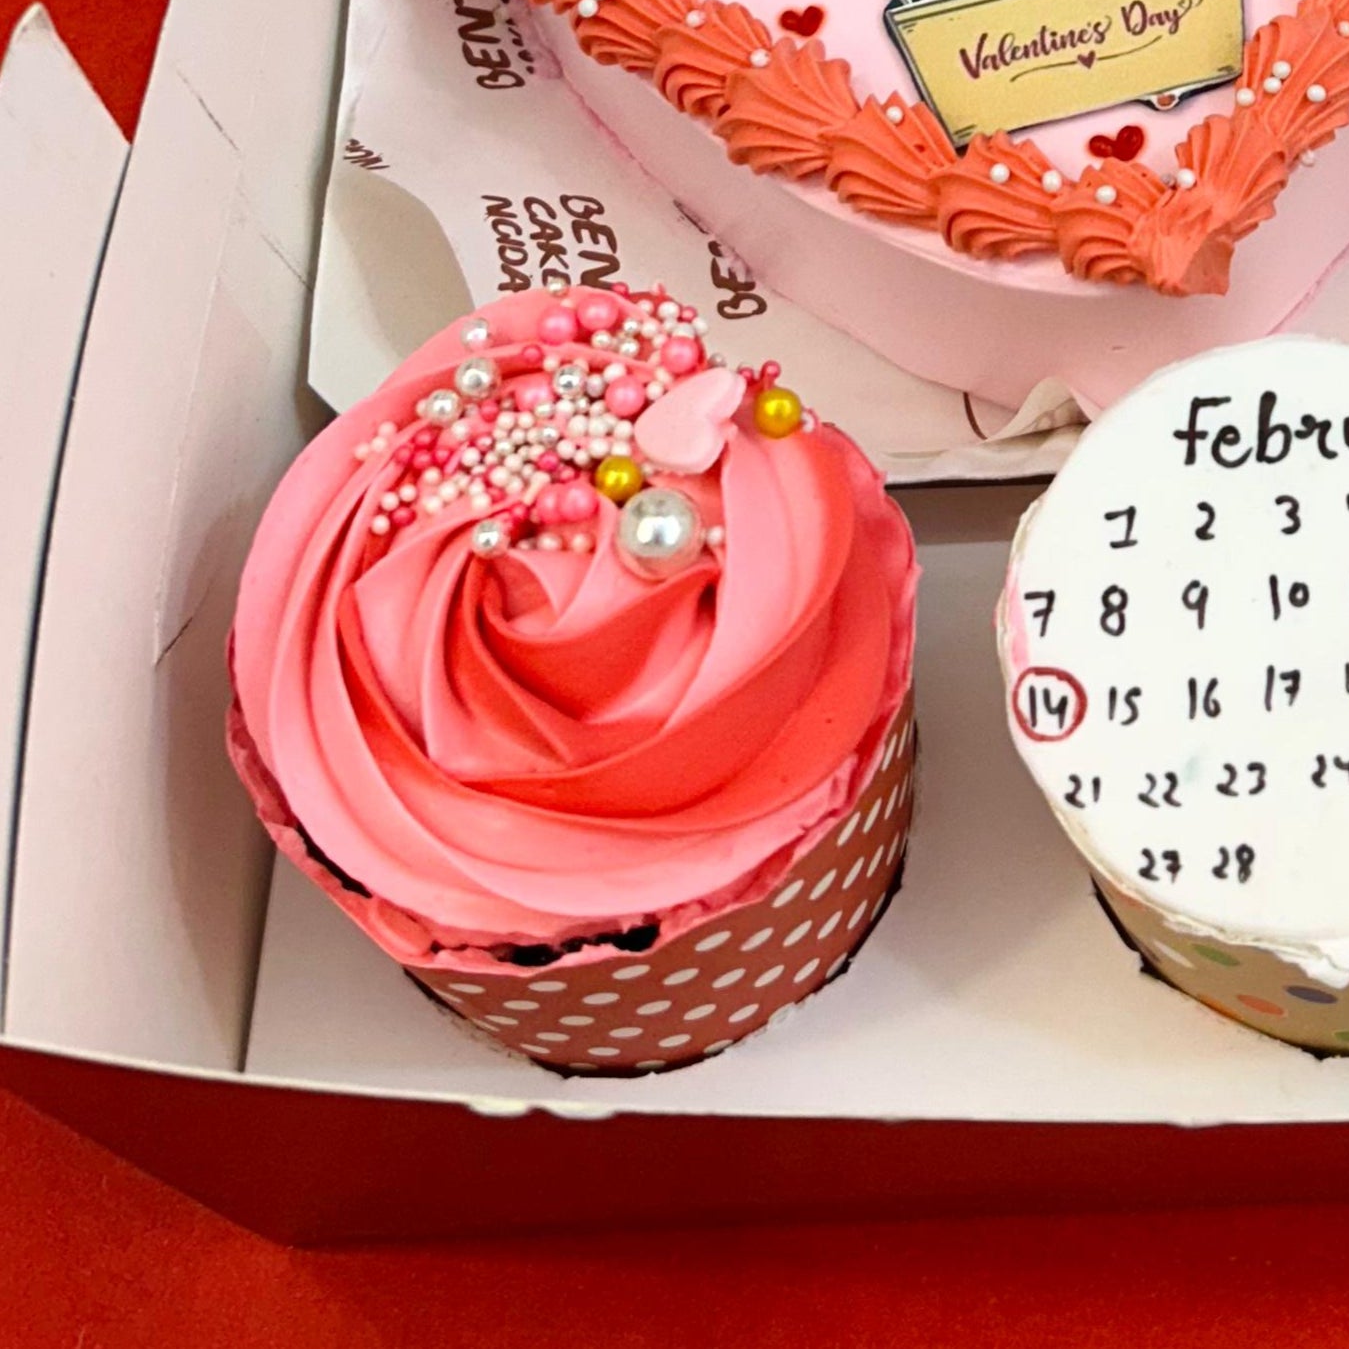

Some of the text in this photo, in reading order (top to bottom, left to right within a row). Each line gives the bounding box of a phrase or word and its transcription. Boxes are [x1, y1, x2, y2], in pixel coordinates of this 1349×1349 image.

[959, 15, 1112, 80] Valentine's
[522, 195, 571, 290] CAKE
[559, 193, 621, 291] BEN
[1105, 506, 1138, 548] 1
[1195, 501, 1217, 541] 2
[1274, 495, 1302, 535] 3
[1024, 589, 1056, 638] 7
[1100, 584, 1129, 637] 8
[1181, 579, 1209, 631] 9
[1269, 574, 1311, 621] 10
[1027, 684, 1069, 730] 14
[1107, 685, 1143, 726] 15
[1187, 676, 1222, 721] 16
[1264, 665, 1302, 712] 17
[1064, 774, 1102, 809] 21
[1137, 771, 1182, 808] 22
[1215, 762, 1267, 797] 23
[1137, 843, 1256, 884] 27 28
